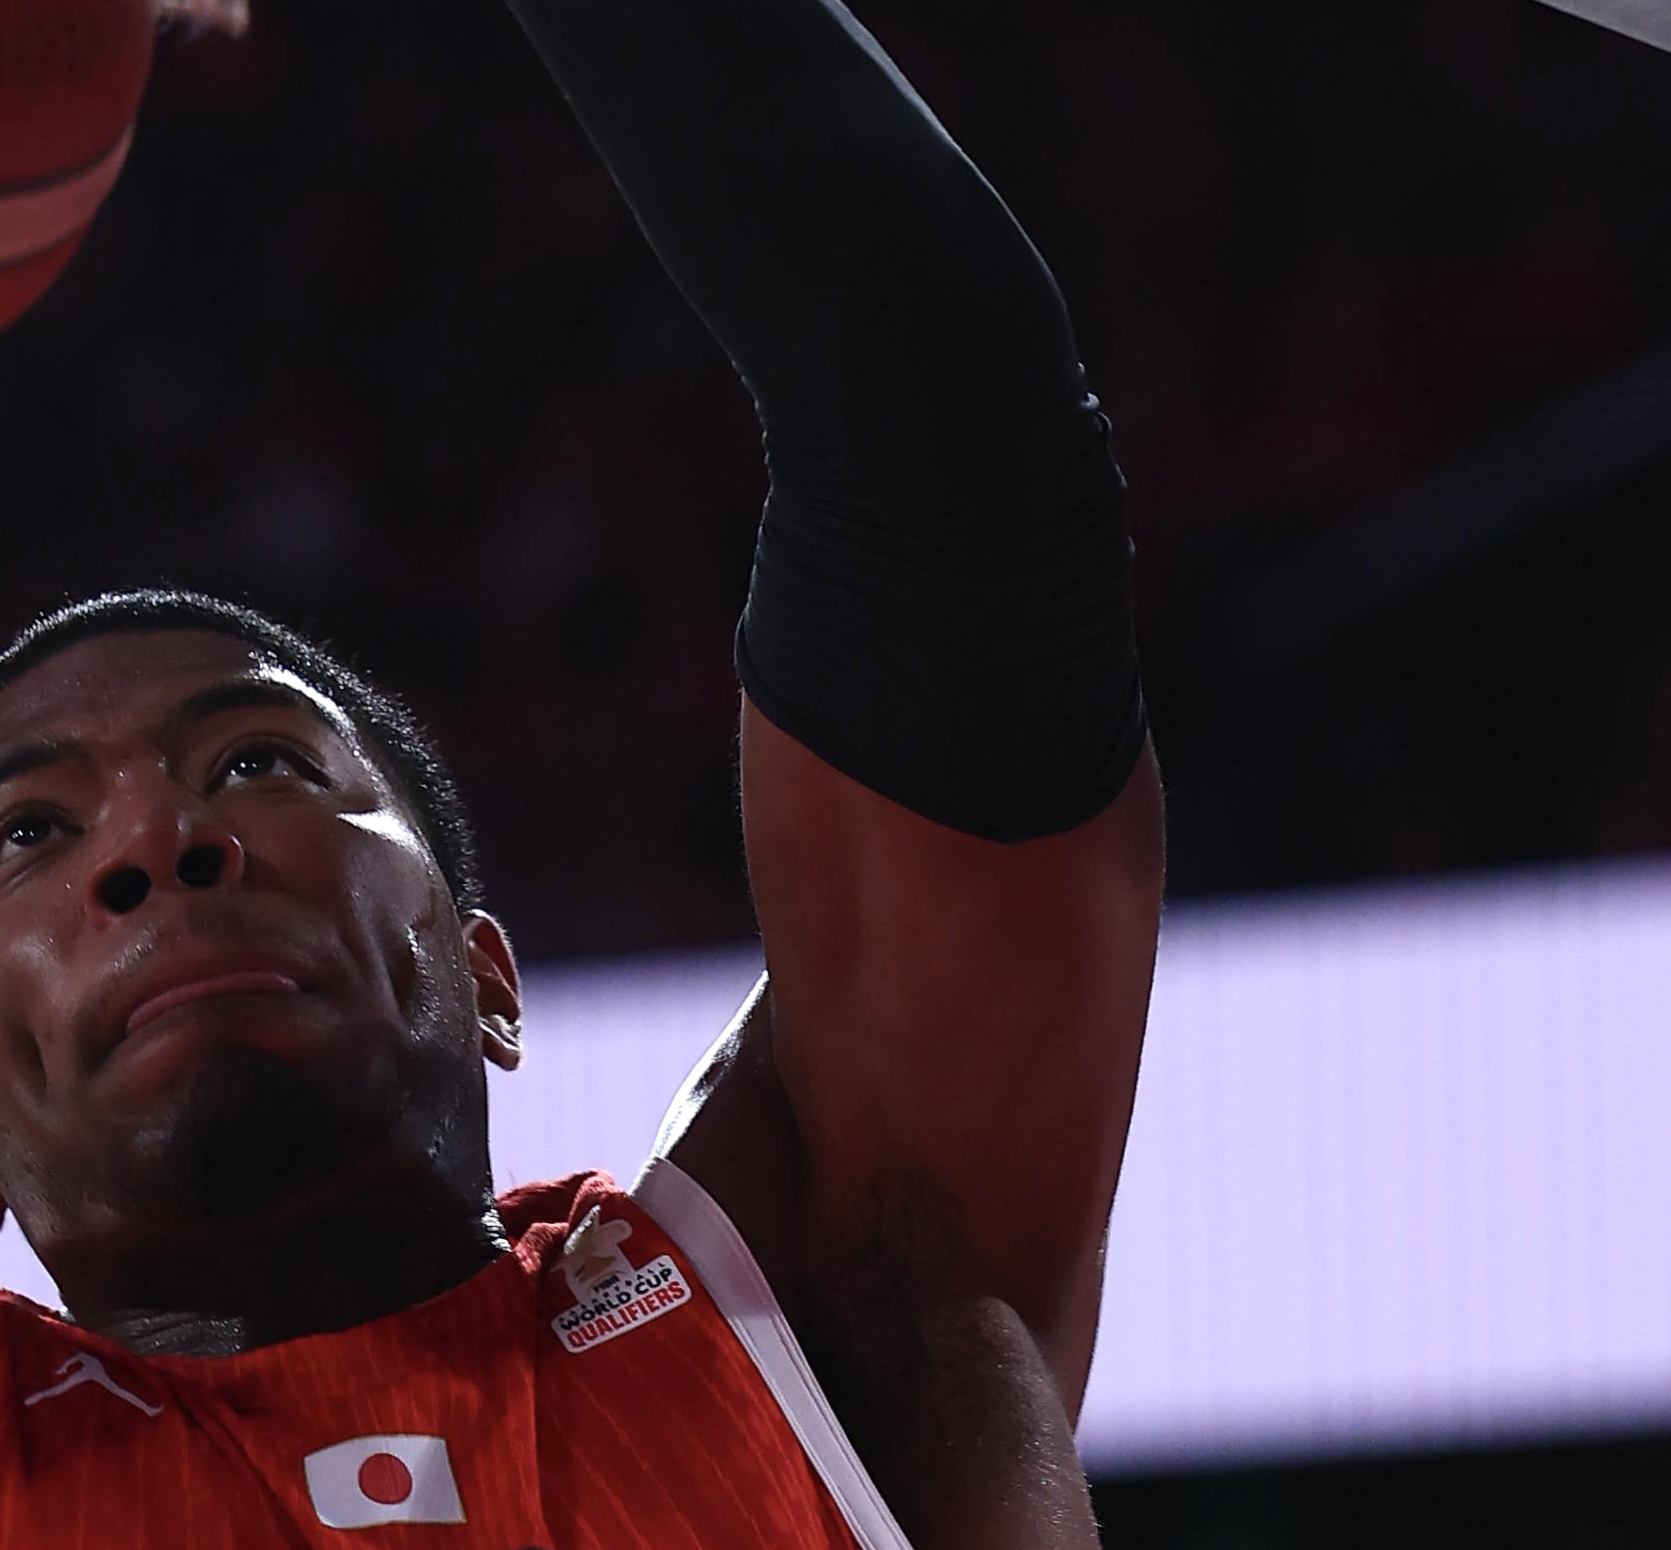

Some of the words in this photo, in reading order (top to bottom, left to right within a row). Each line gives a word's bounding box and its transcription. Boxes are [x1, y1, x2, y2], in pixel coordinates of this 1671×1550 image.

[560, 1292, 631, 1330] WORLD
[634, 1268, 672, 1295] CUP
[567, 1281, 685, 1347] QUALIFIERS
